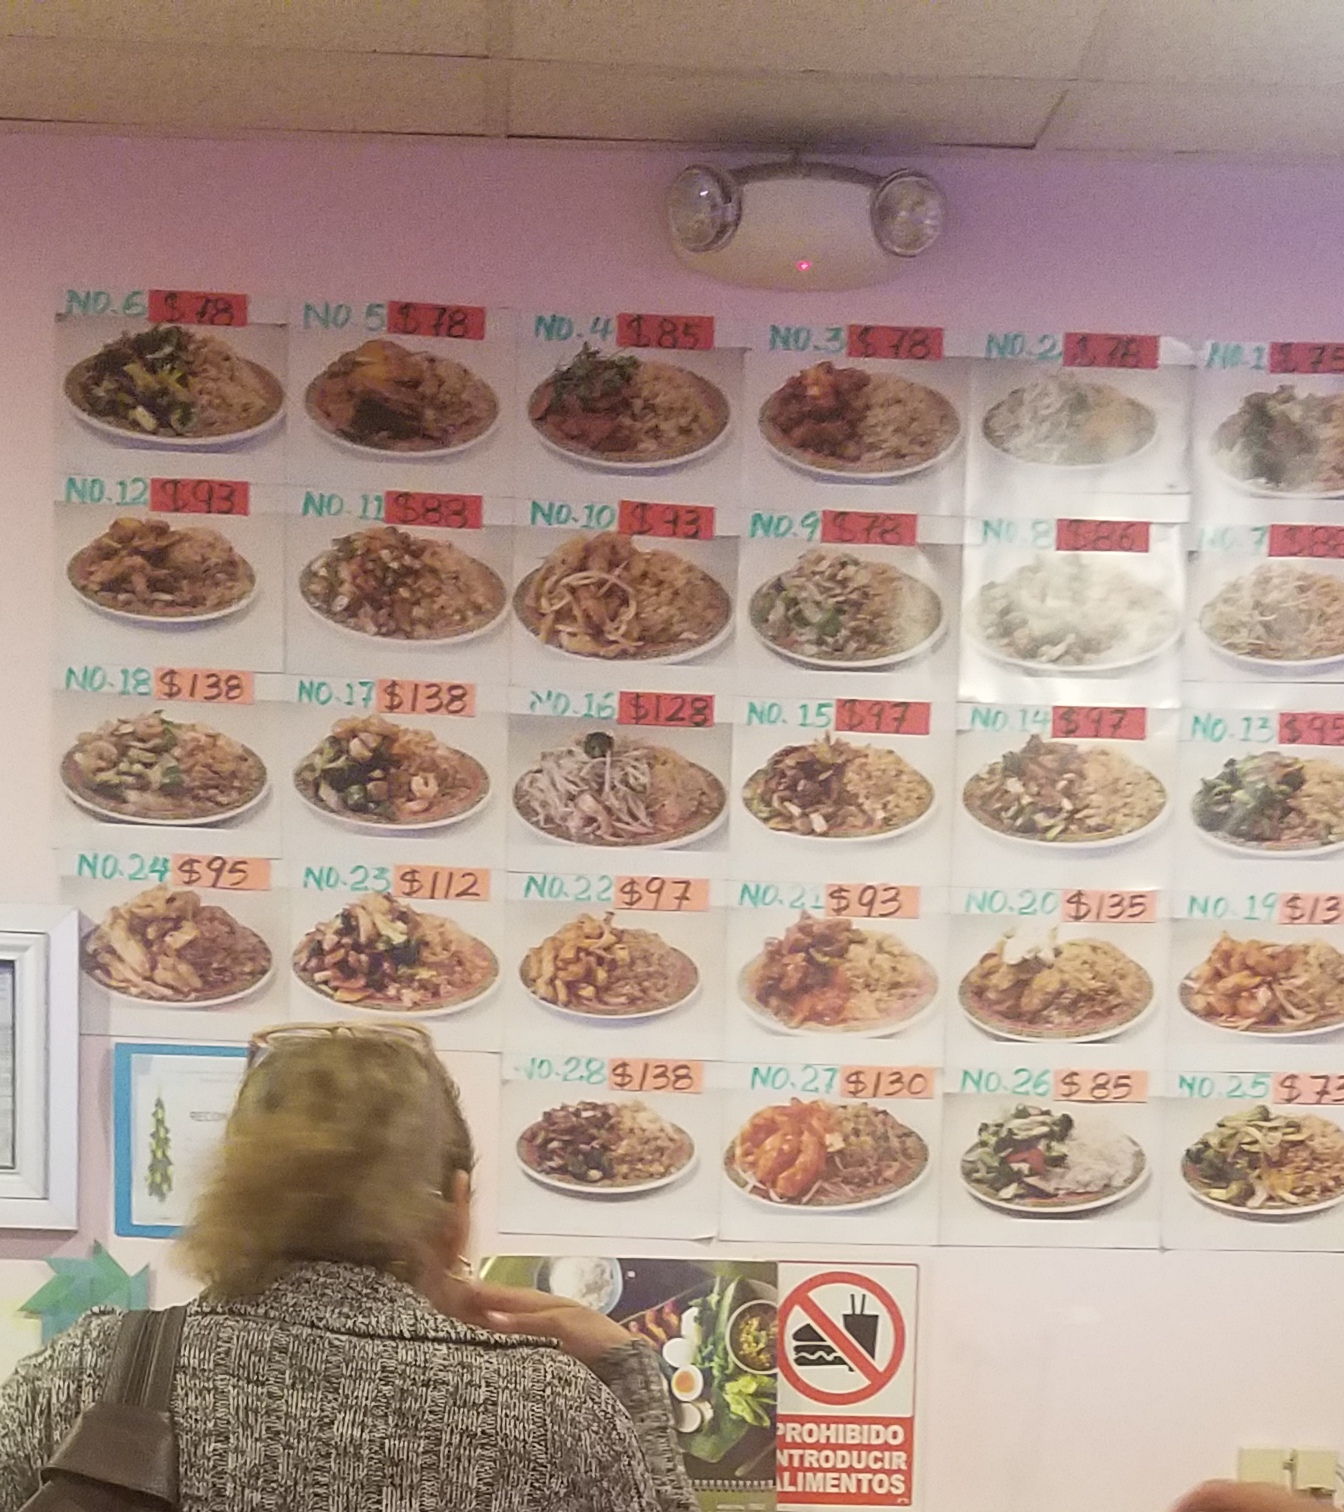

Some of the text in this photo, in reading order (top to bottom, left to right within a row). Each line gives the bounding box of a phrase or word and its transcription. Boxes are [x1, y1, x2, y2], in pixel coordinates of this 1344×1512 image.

[67, 289, 146, 316] NO.6
[535, 314, 699, 349] NO.4 $85
[769, 324, 846, 352] NO.3
[65, 477, 235, 514] NO.12 $93
[302, 491, 383, 521] NO.11
[530, 501, 615, 530] NO.10
[750, 510, 900, 545] NO.9 $78
[65, 666, 244, 700] NO.18 $138
[298, 680, 468, 715] NO.17 $138
[630, 692, 709, 727] $128
[746, 699, 910, 734] NO.15 $97
[1060, 707, 1126, 738] $97
[1191, 713, 1275, 743] NO.13
[77, 853, 248, 888] NO.24 $95
[304, 864, 477, 900] NO.23 $112
[522, 874, 692, 910] NO.22 $97
[828, 885, 902, 917] $93
[964, 890, 1147, 922] NO.20 $135
[612, 1061, 694, 1091] $138
[750, 1064, 928, 1098] NO.27 $130
[960, 1068, 1133, 1100] NO.26 $85
[776, 1422, 905, 1445] PROHIBIDO
[776, 1449, 908, 1470] NTRODUCIR
